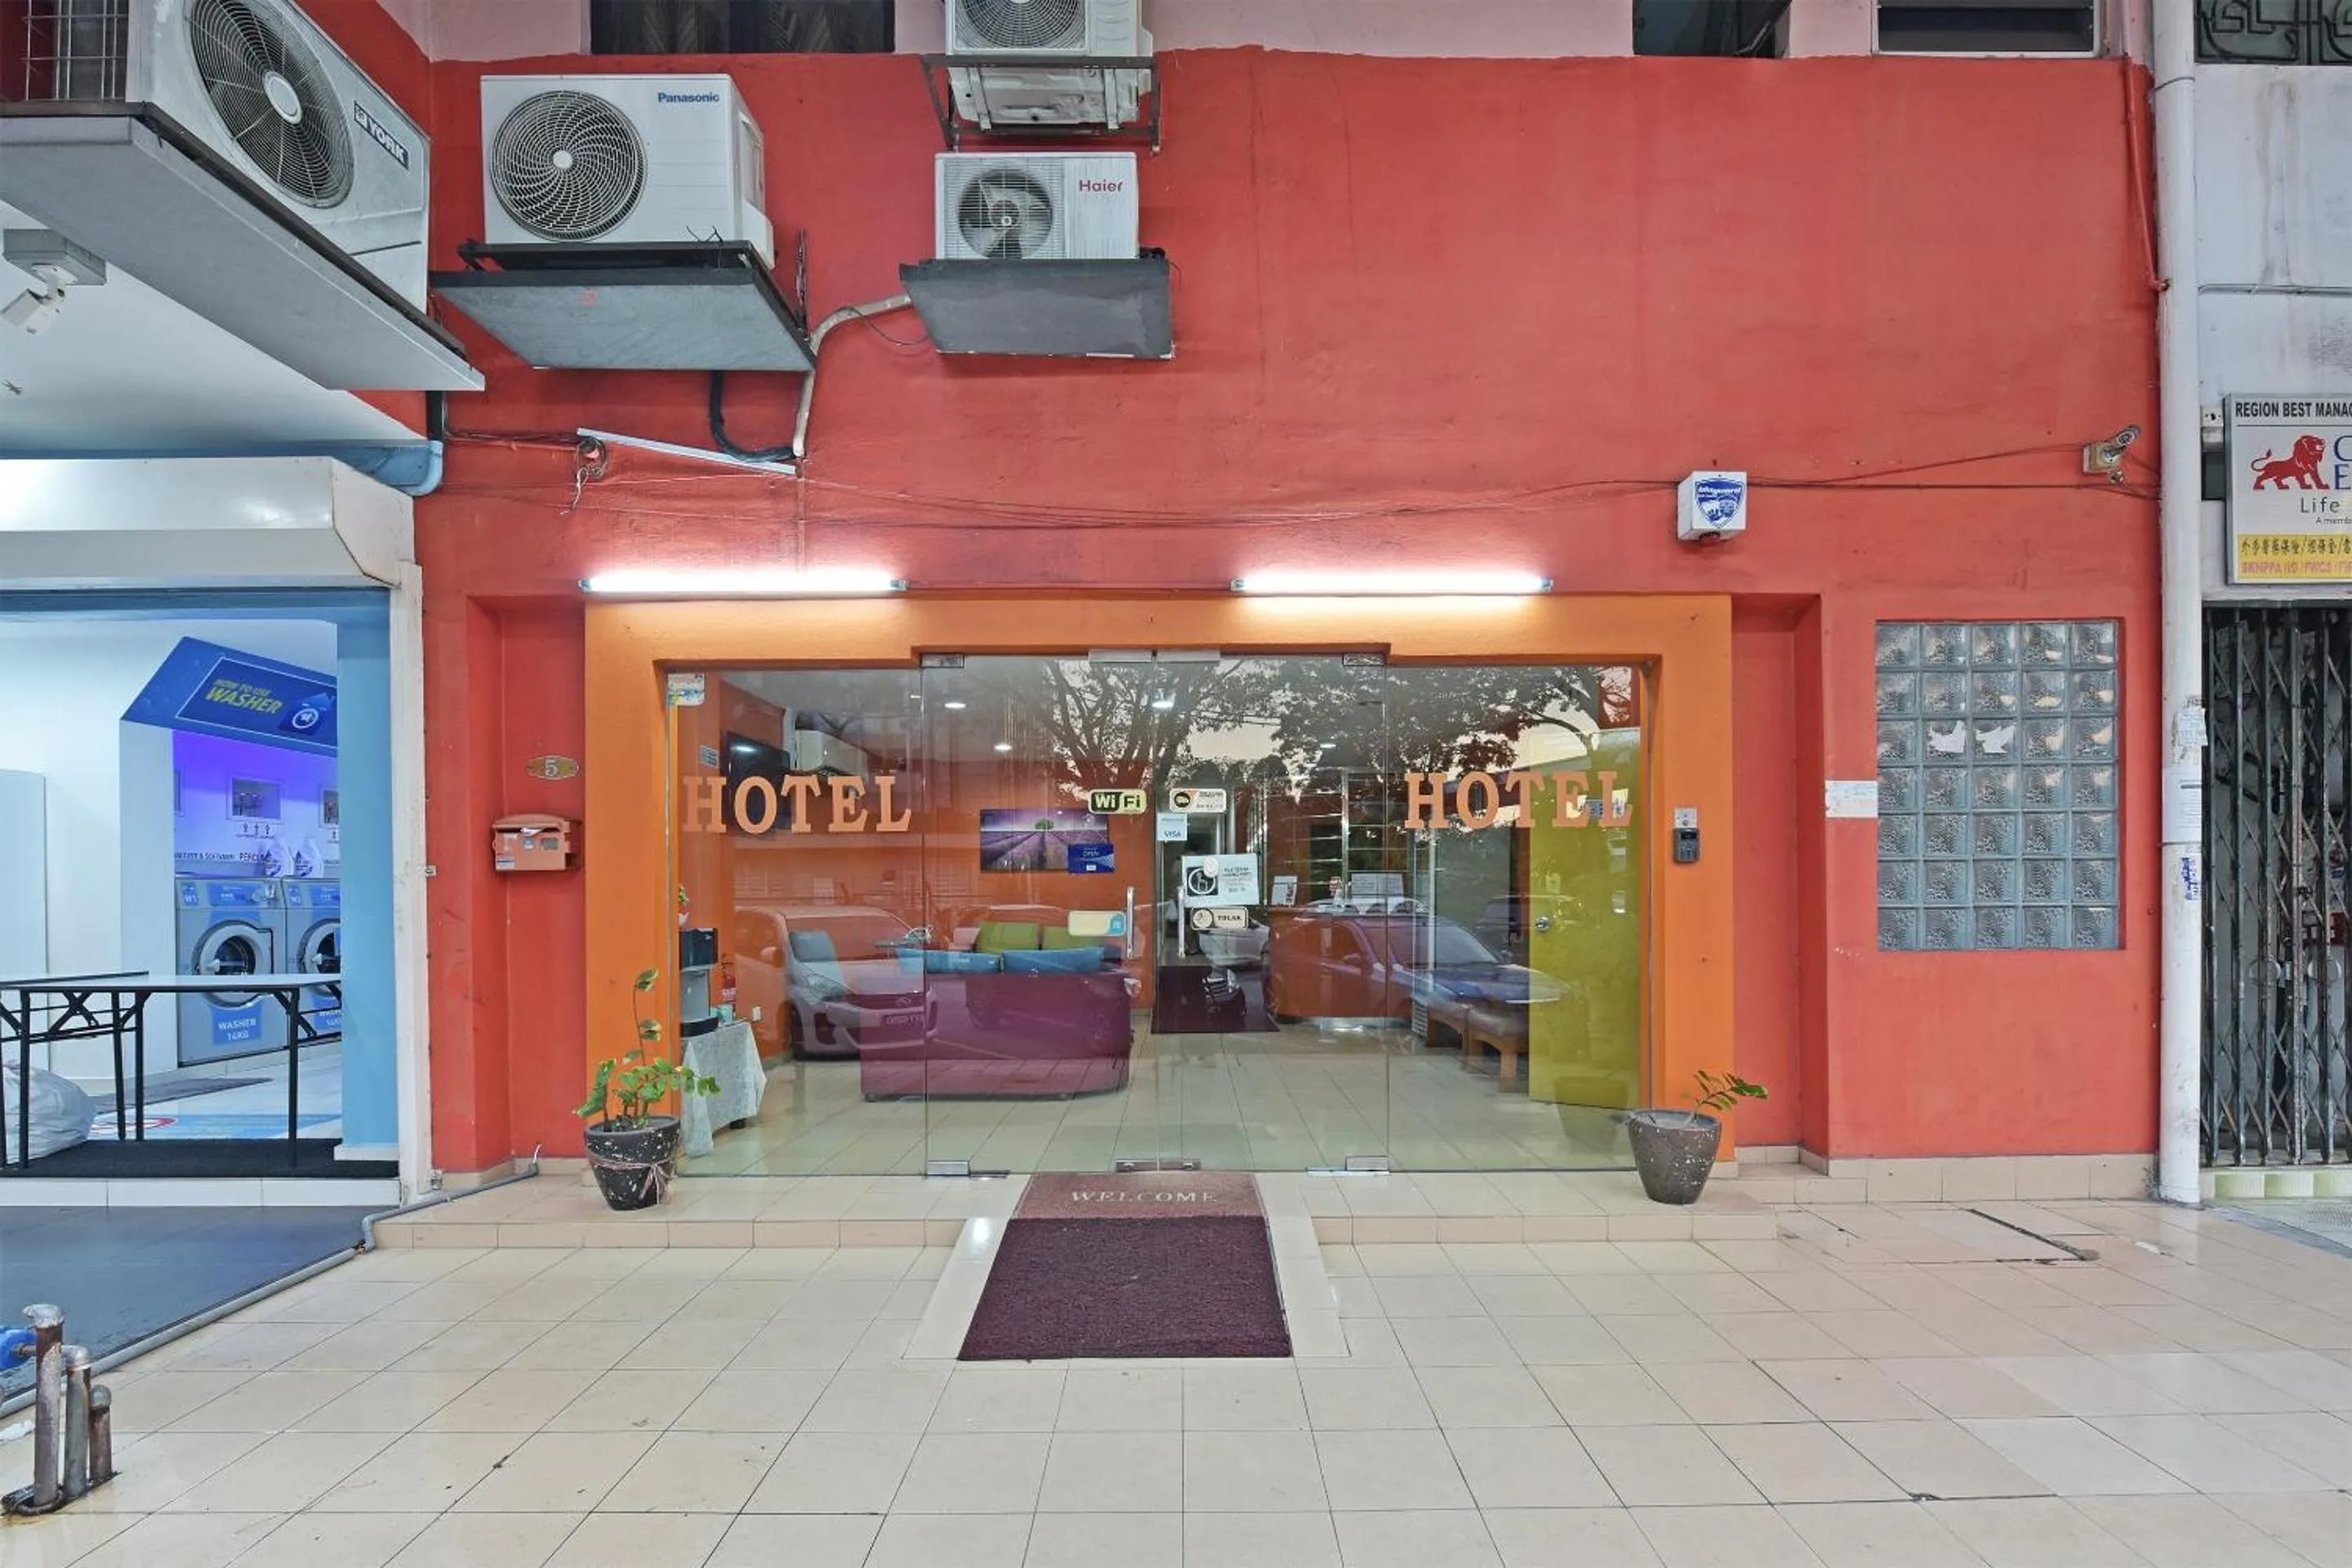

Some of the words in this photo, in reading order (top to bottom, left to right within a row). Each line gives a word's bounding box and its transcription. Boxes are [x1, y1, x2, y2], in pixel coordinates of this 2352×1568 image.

[657, 91, 719, 103] Panasonic
[368, 116, 407, 165] YORK
[1079, 179, 1123, 192] Haier
[2235, 402, 2279, 417] REGION
[2283, 402, 2312, 417] BEST
[2301, 497, 2341, 513] Life
[206, 686, 284, 715] WASHER
[545, 759, 559, 777] 5
[681, 774, 929, 834] HOTEL
[1405, 771, 1633, 830] HOTEL
[218, 1018, 256, 1030] WASHER
[1071, 1191, 1218, 1203] WELCOME
